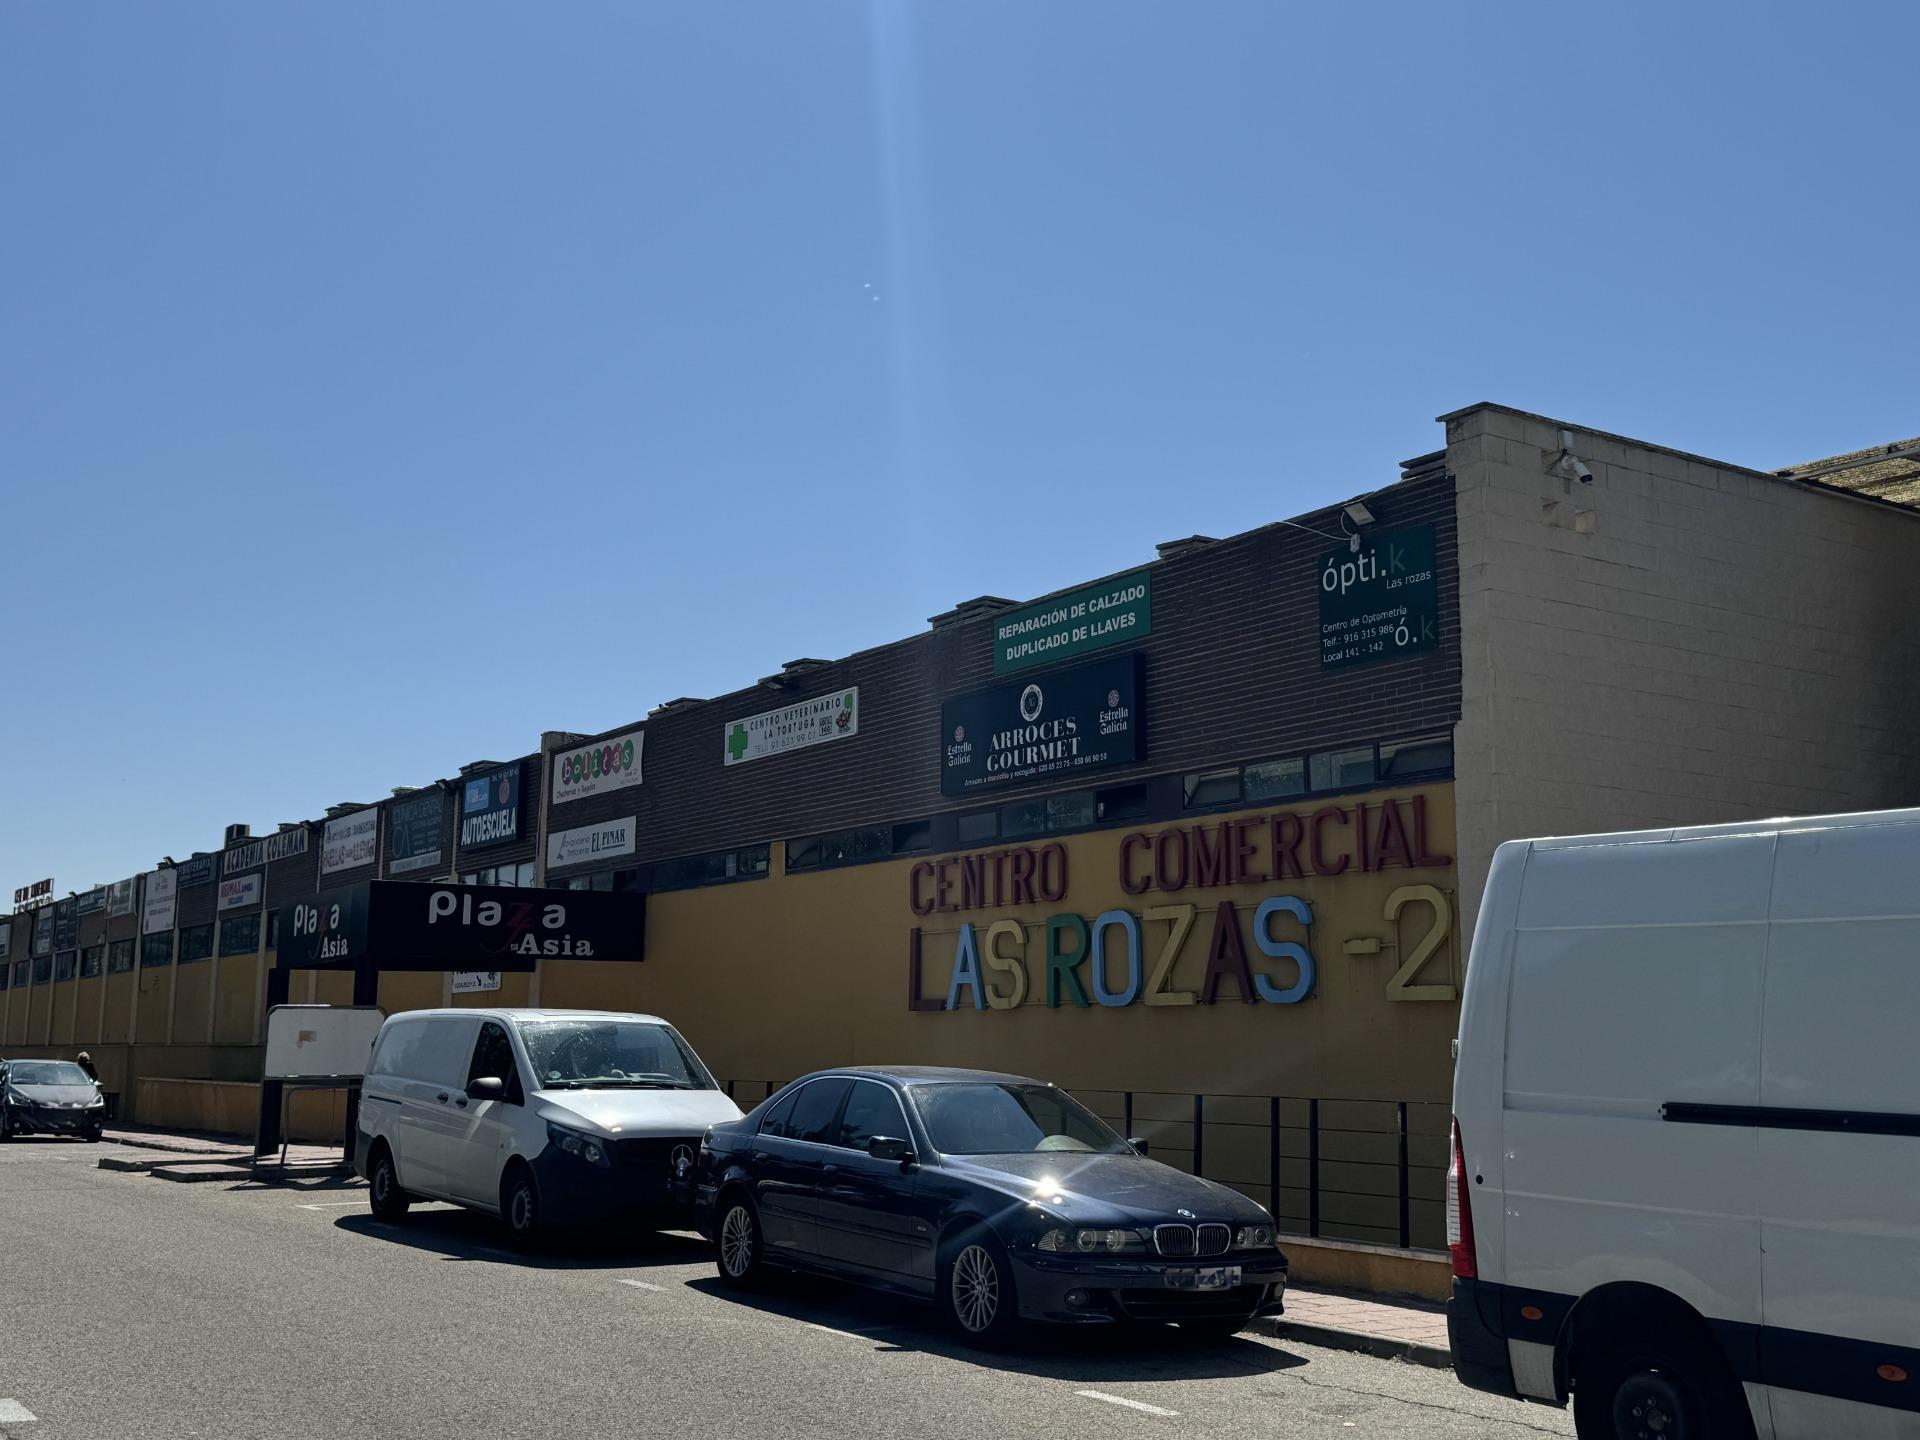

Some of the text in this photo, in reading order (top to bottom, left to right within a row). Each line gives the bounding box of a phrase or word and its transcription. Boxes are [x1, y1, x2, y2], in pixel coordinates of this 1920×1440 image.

[1386, 570, 1431, 589] Las rozas
[999, 584, 1145, 640] REPARACIÓN DE CALZADO
[1322, 604, 1408, 633] Centro de Optometría
[1006, 611, 1136, 661] DUPLICADO DE LLAVES
[1344, 631, 1359, 643] 916
[1361, 627, 1377, 640] 315
[1379, 623, 1395, 636] 986
[1323, 651, 1343, 663] Local
[1346, 647, 1360, 659] 141
[1369, 640, 1385, 653] 142
[750, 698, 841, 731] CENTRO VETERINARIO
[1100, 706, 1129, 723] Estrella
[764, 718, 815, 740] LA TORTUGA
[990, 716, 1077, 751] ARROCES
[1100, 720, 1127, 735] Galicia
[948, 742, 972, 756] Estrella
[949, 754, 971, 767] Galicia
[986, 737, 1081, 772] GOURMET
[461, 806, 516, 846] AUTOESCUELA
[592, 828, 625, 852] EL PINAR
[226, 841, 264, 871] ACADEMIA
[909, 795, 1452, 916] CENTRO COMERCIAL
[321, 934, 349, 959] Asia
[517, 933, 594, 956] Asia
[909, 919, 1028, 1012] LAS
[1047, 896, 1316, 1009] ROZAS
